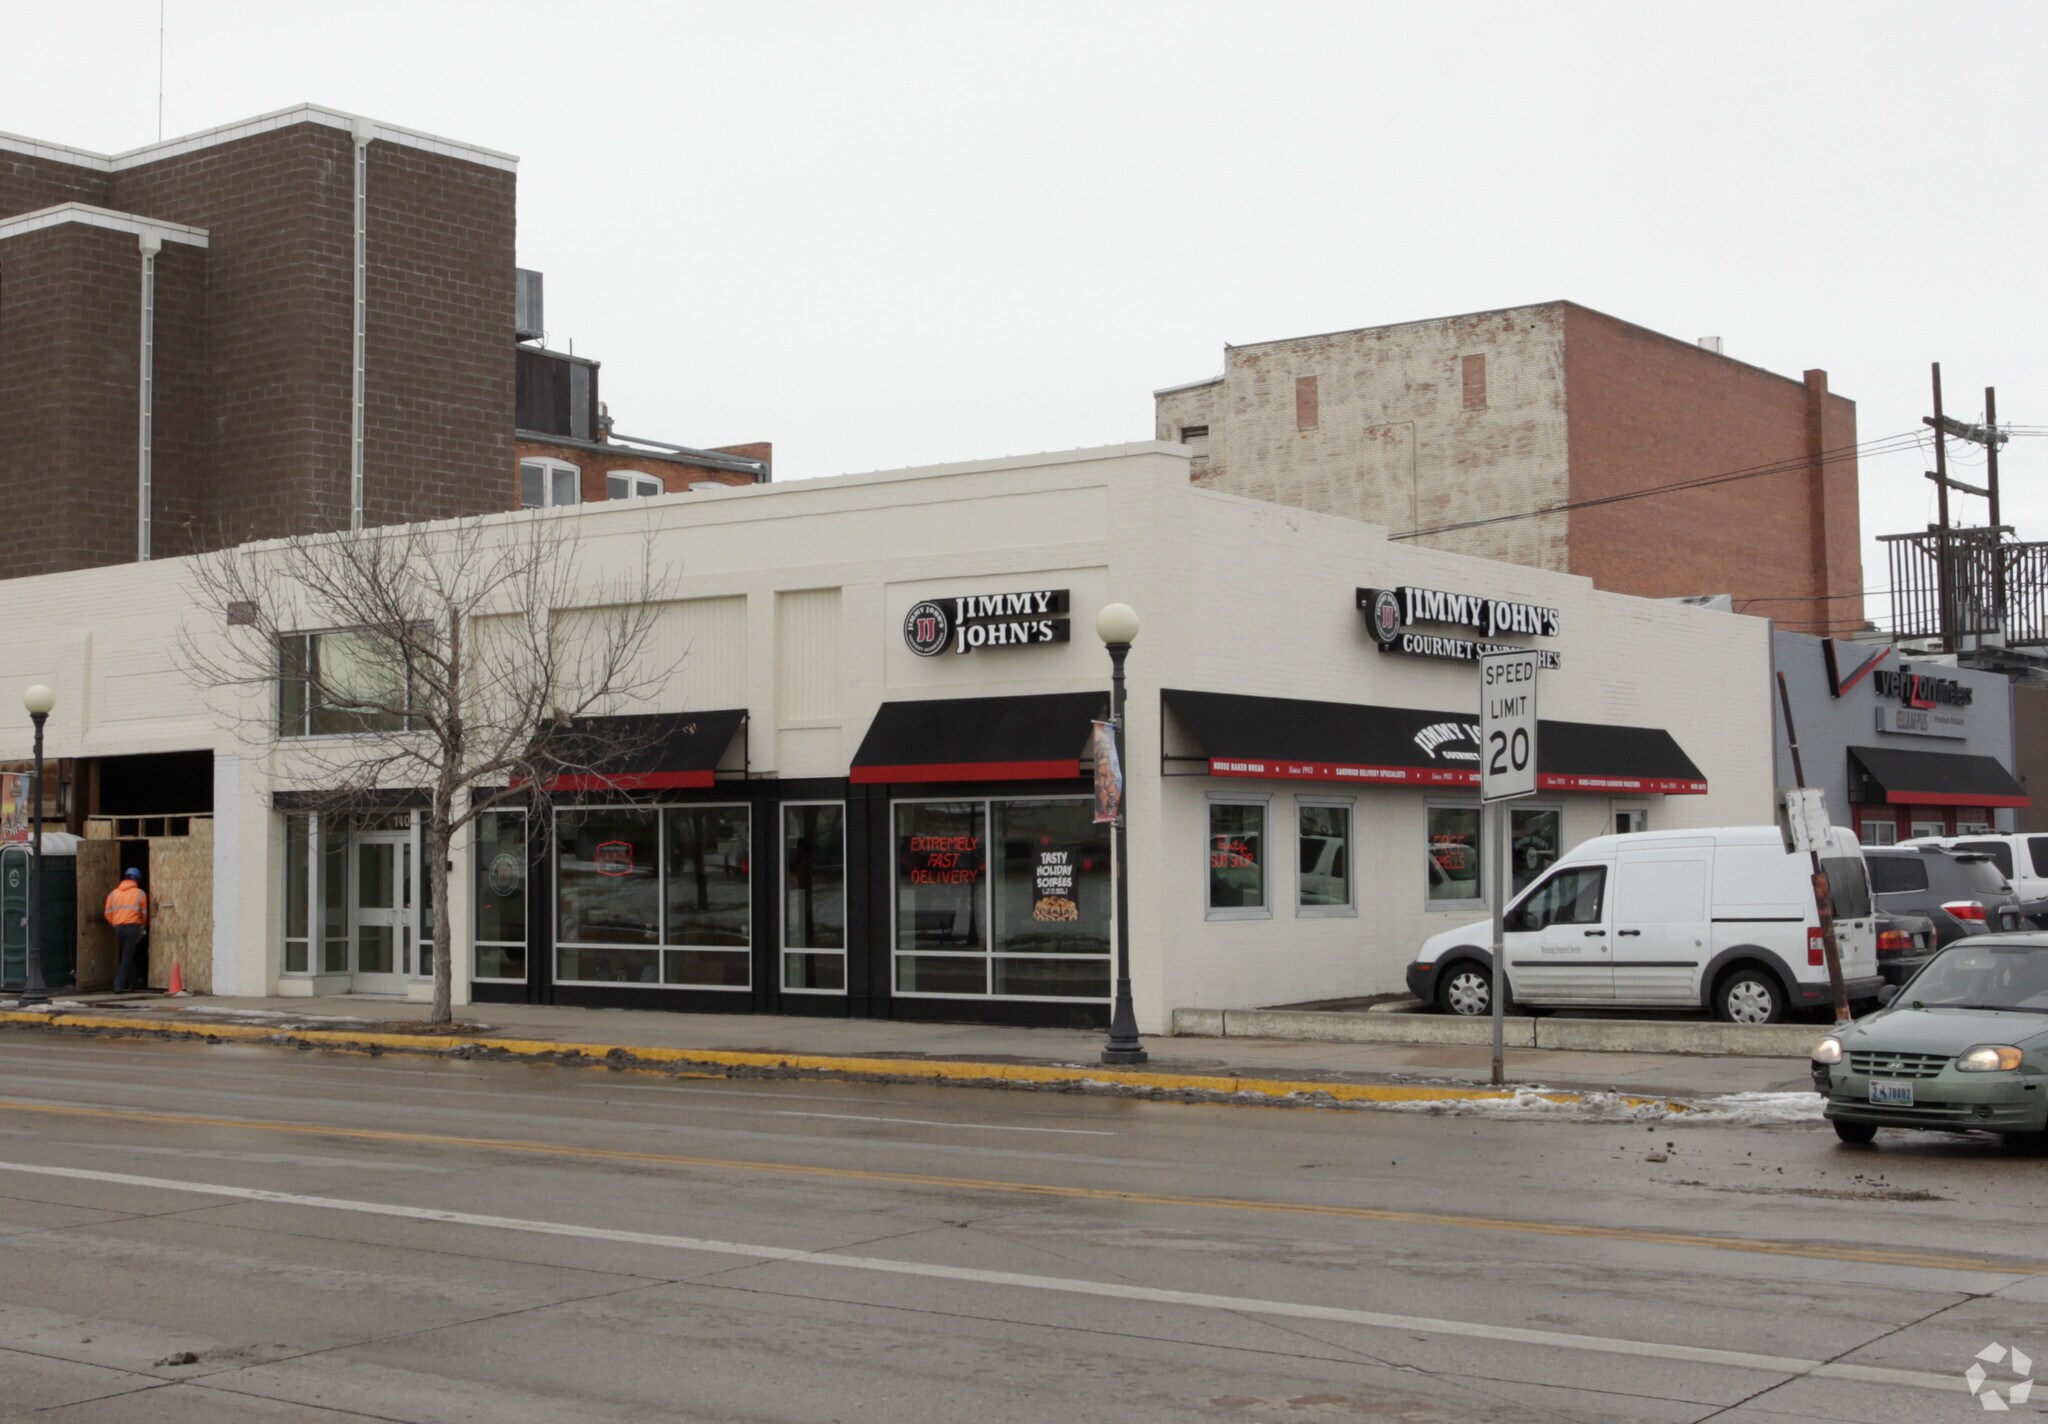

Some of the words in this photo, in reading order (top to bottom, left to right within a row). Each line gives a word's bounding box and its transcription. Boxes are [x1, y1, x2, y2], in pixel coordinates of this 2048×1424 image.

[908, 606, 924, 630] JIMMY
[926, 606, 944, 628] JOHN'S
[955, 591, 1051, 625] JIMMY
[1405, 587, 1482, 626] JIMMY
[1487, 600, 1559, 637] JOHN'S
[917, 618, 935, 642] JJ
[956, 620, 1053, 653] JOHN'S
[1403, 633, 1473, 659] GOURMET
[1486, 662, 1533, 685] SPEED
[1881, 670, 1937, 709] verizon
[1937, 680, 1973, 705] wireless
[1491, 696, 1526, 719] LIMIT
[1414, 723, 1465, 759] JIMMY
[1489, 727, 1529, 775] 20
[394, 815, 410, 827] 110
[911, 836, 978, 851] EXTREMELY
[927, 853, 961, 868] FAST
[1041, 852, 1068, 864] TASTY
[911, 869, 978, 884] DELIVERY
[1036, 865, 1072, 876] HOLIDAY
[1036, 876, 1072, 888] SOIRÉES
